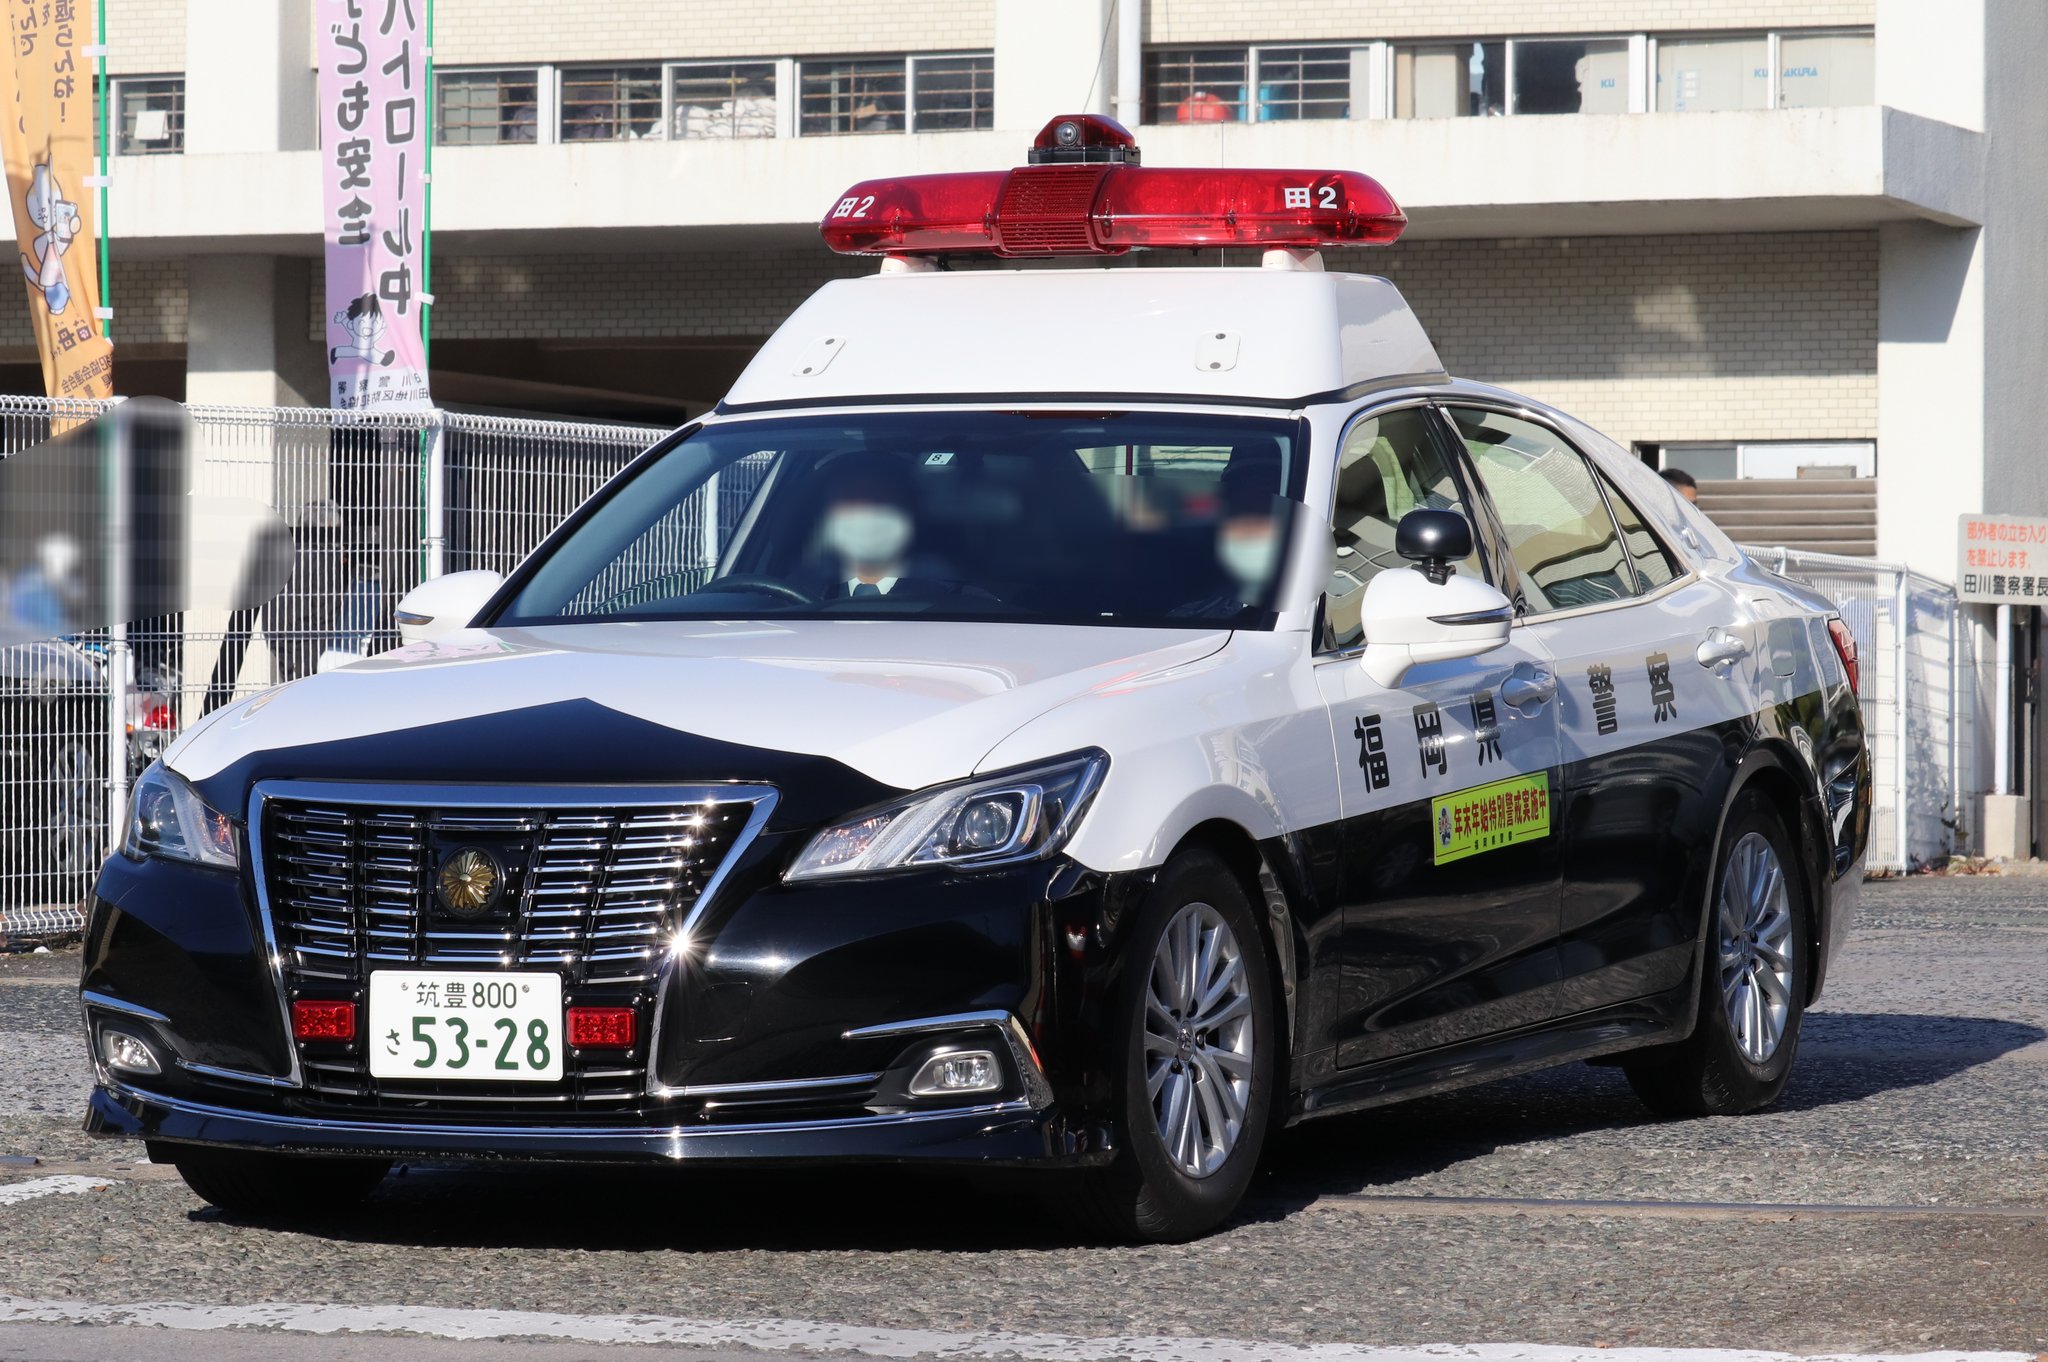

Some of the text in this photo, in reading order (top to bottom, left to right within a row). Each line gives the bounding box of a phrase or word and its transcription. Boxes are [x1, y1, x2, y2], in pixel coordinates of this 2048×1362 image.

[1964, 574, 2048, 597] 田川警察署長
[385, 1016, 551, 1071] さ 53-28
